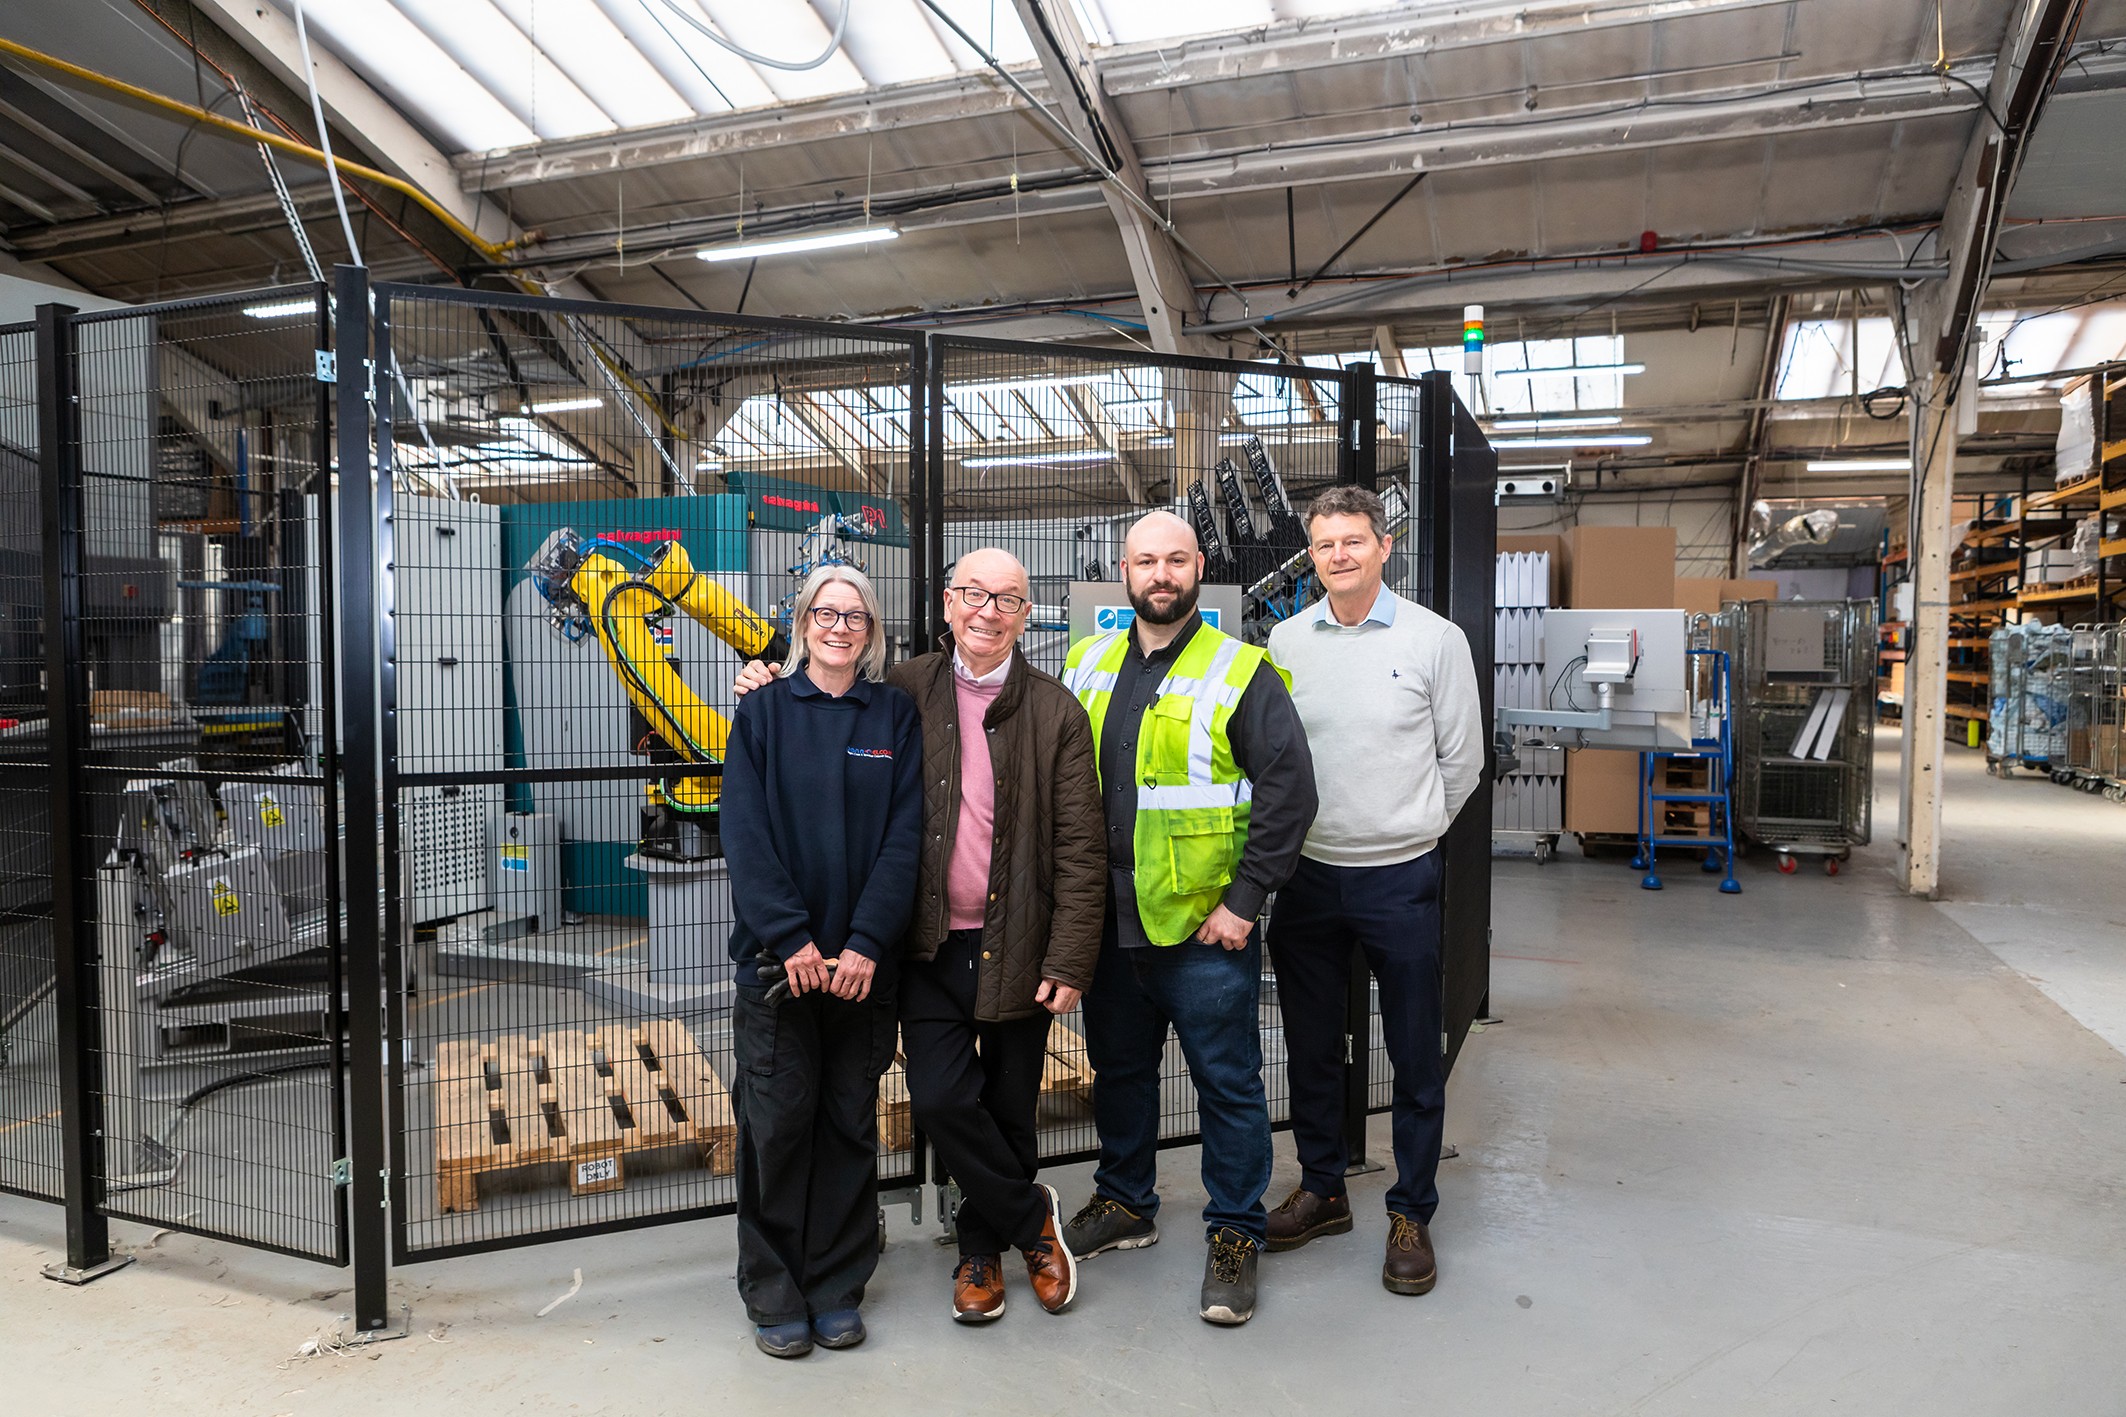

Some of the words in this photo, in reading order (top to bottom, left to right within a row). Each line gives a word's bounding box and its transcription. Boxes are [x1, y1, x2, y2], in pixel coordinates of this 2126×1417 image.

[762, 495, 820, 512] salvagnini
[597, 528, 682, 544] salvagnini
[581, 1160, 613, 1173] ROBOT
[586, 1170, 611, 1181] ONLY
